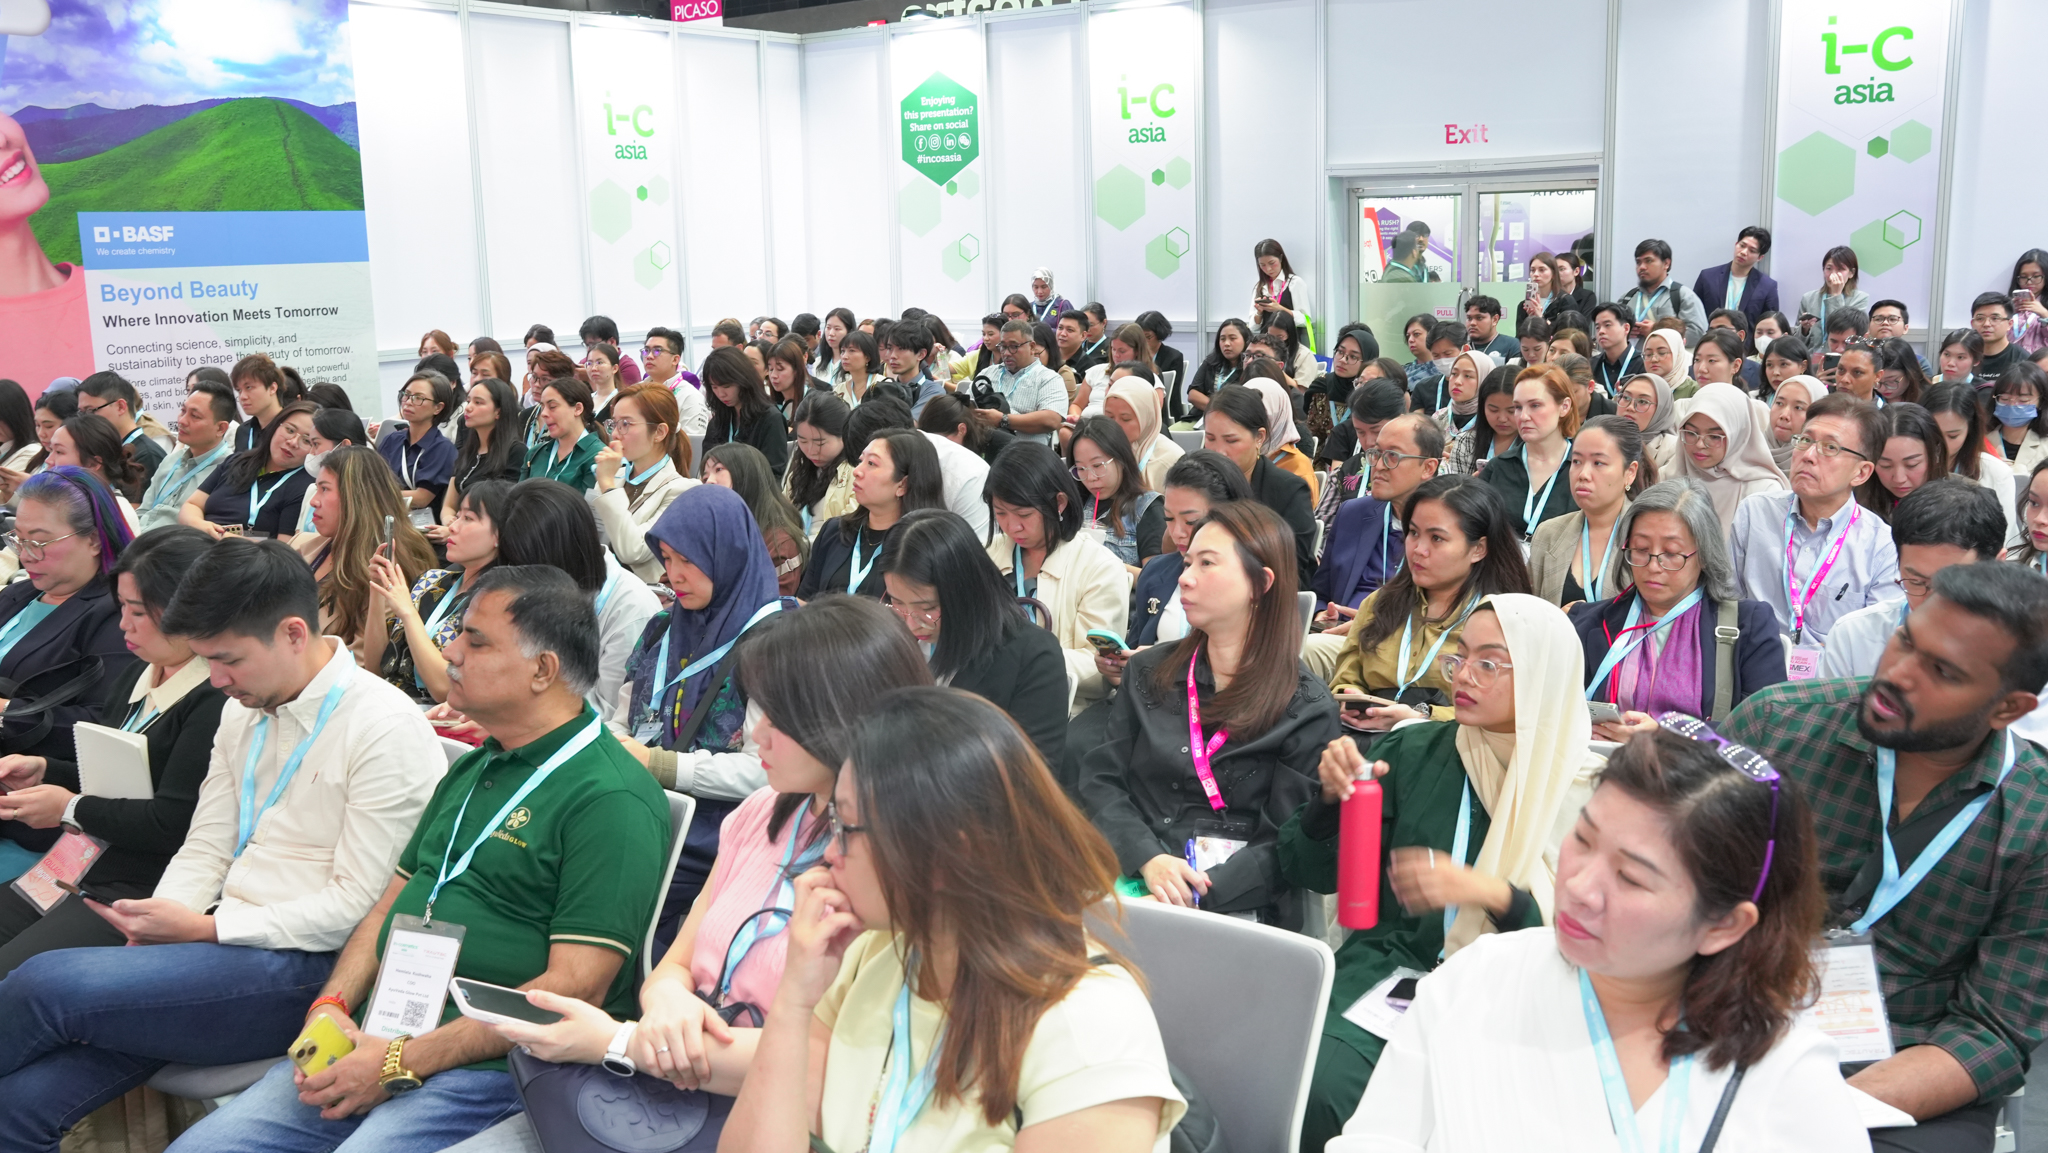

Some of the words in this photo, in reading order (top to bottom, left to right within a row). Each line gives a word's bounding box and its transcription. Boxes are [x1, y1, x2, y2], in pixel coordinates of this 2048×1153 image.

[674, 0, 718, 20] PICASO
[1834, 76, 1895, 105] asia
[920, 95, 956, 107] Enjoying
[903, 110, 919, 120] this
[920, 105, 974, 120] presentation?
[909, 122, 932, 132] Share
[933, 122, 944, 130] on
[945, 119, 969, 130] social
[1128, 121, 1167, 144] asia
[1444, 124, 1489, 144] Exit
[615, 139, 648, 160] asia
[916, 152, 962, 164] #incosasia
[122, 226, 174, 242] BASF
[96, 248, 110, 256] We
[111, 247, 136, 256] create
[138, 246, 176, 256] chemistry
[100, 281, 183, 306] Beyond
[190, 280, 259, 301] Beauty
[102, 315, 151, 328] Where
[155, 310, 229, 326] Innovation
[233, 308, 271, 321] Meets
[274, 306, 339, 319] Tomorrow
[1436, 309, 1454, 317] PULL
[106, 342, 173, 356] Connecting
[176, 339, 222, 351] science,
[224, 335, 276, 349] simplicity,
[278, 333, 297, 344] and
[108, 356, 183, 372] sustainability
[186, 355, 197, 366] to
[199, 353, 233, 366] shape
[292, 347, 303, 357] of
[305, 345, 353, 357] tomorrow.
[302, 365, 315, 376] yet
[317, 362, 350, 374] powerful
[155, 388, 173, 398] and
[332, 374, 347, 383] and
[152, 401, 175, 411] skin,
[35, 865, 52, 883] Vegan
[43, 858, 67, 880] COLLAGEN
